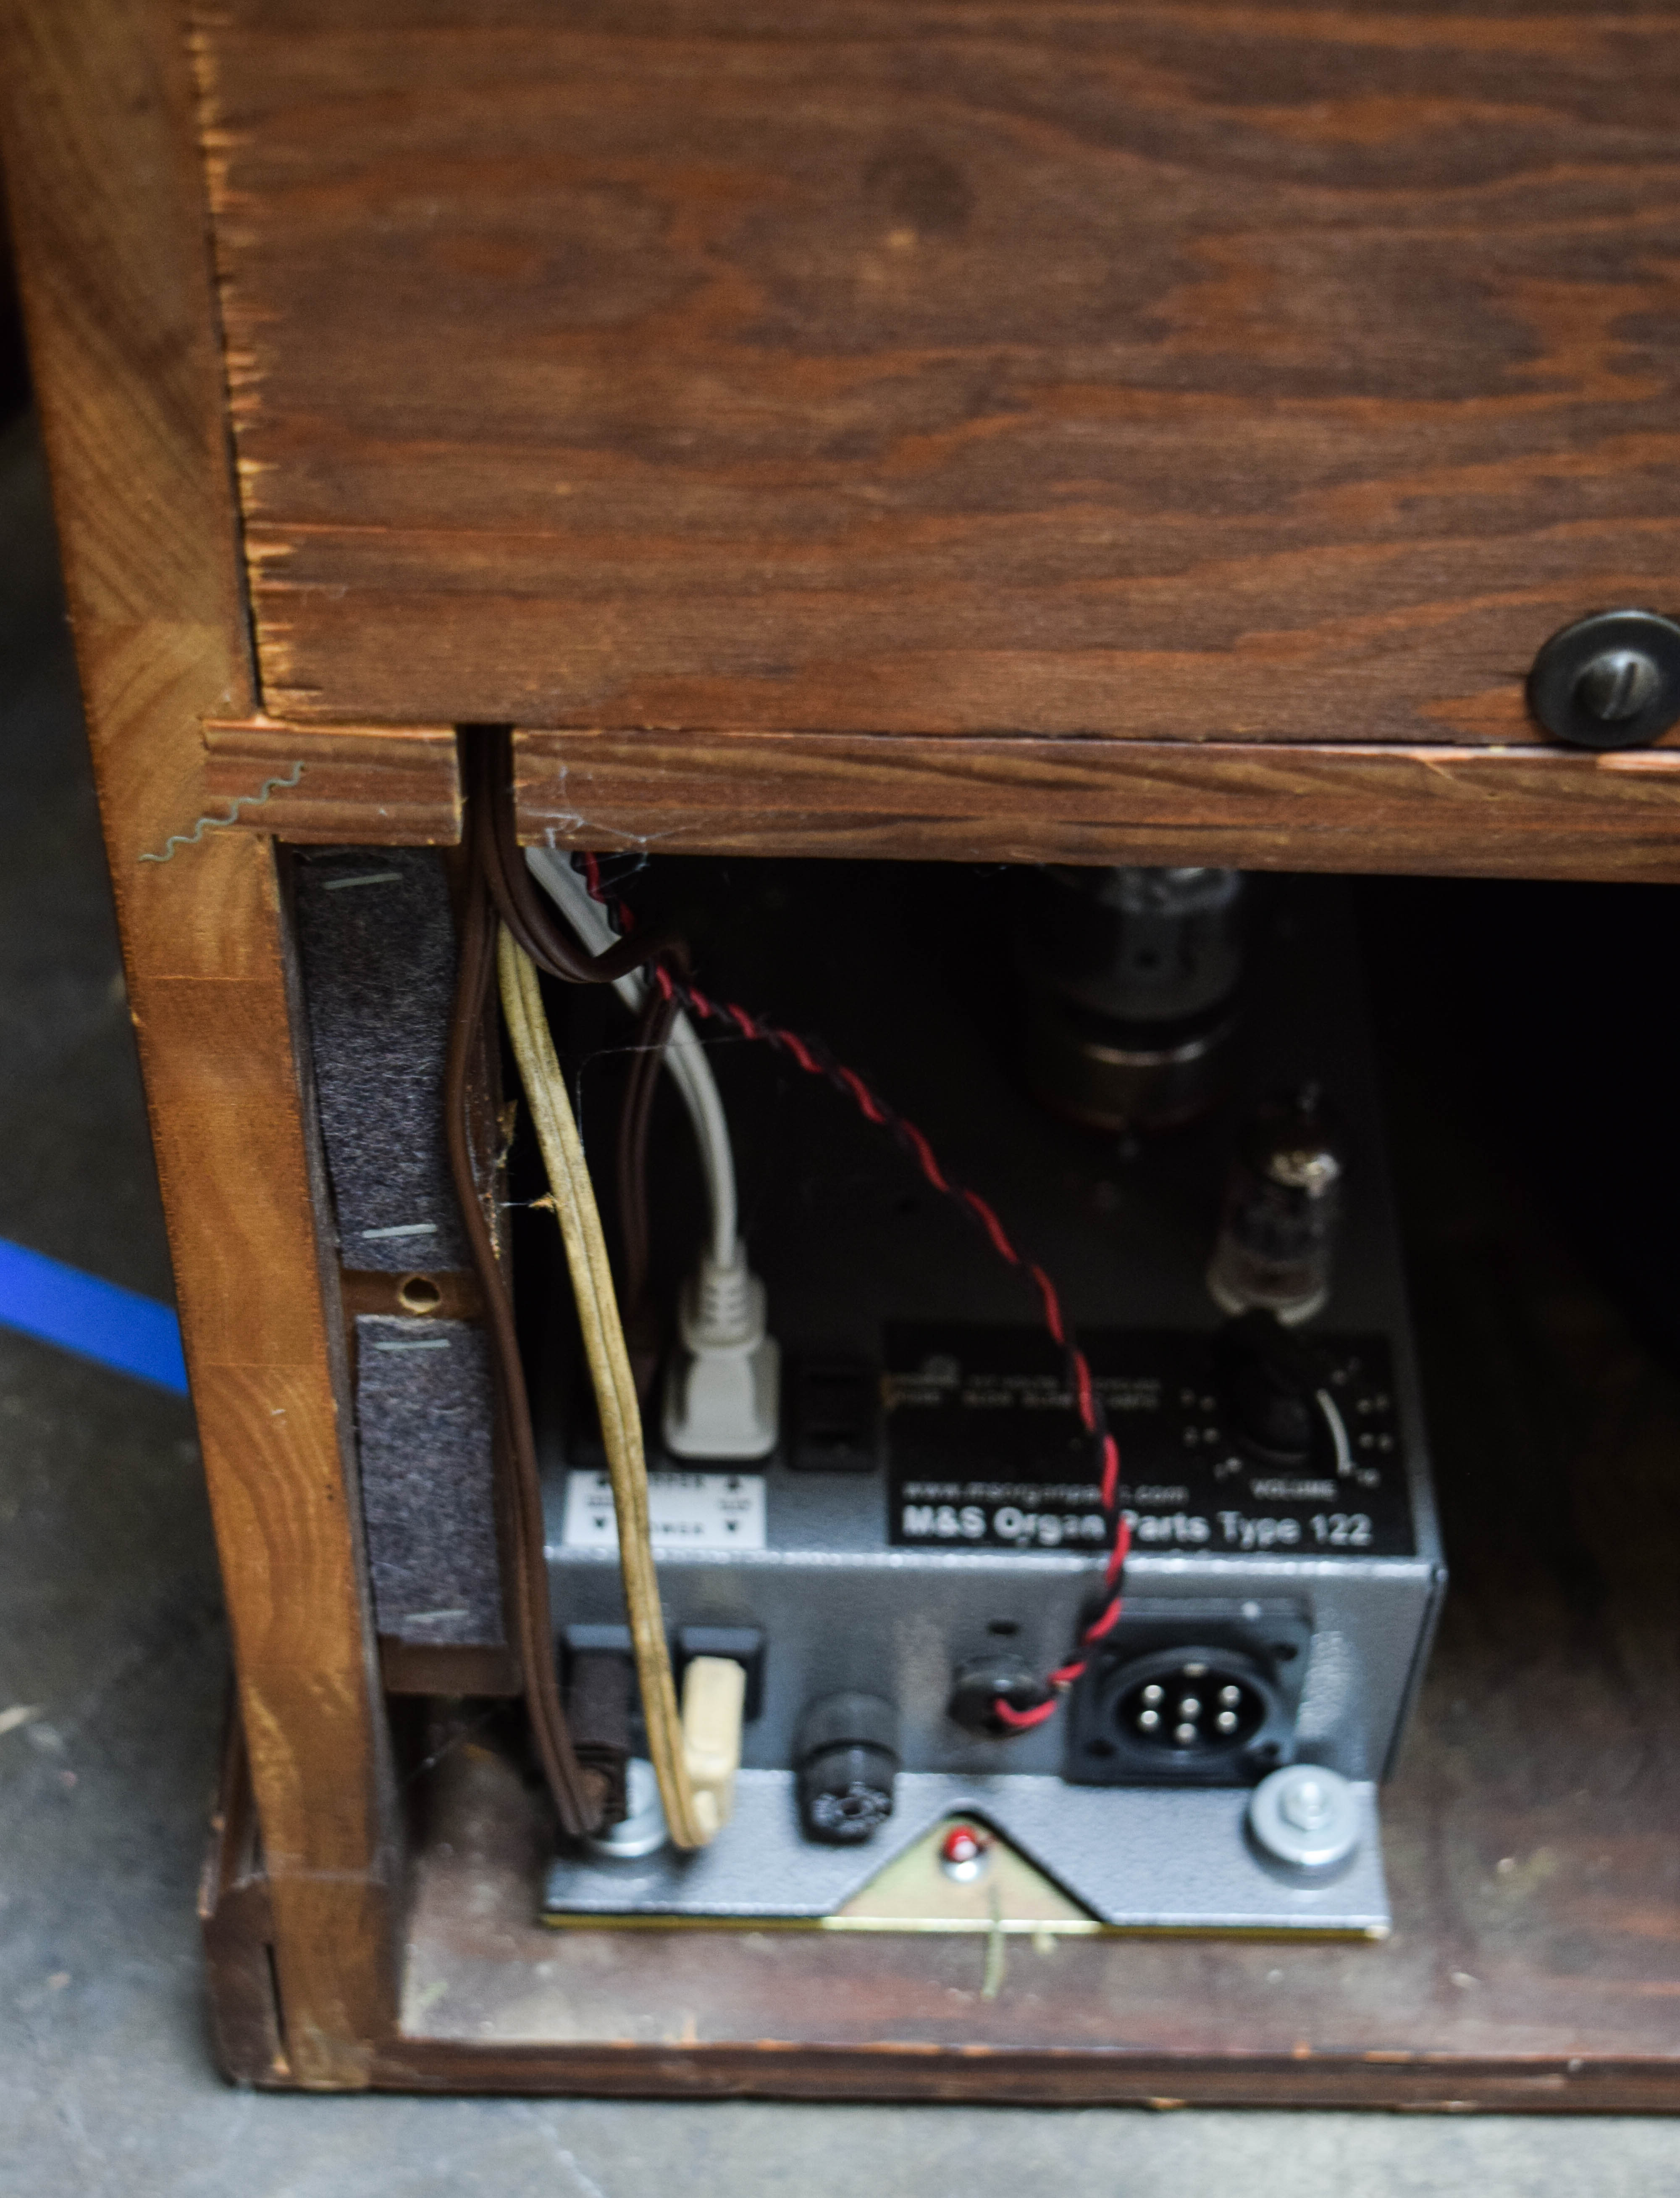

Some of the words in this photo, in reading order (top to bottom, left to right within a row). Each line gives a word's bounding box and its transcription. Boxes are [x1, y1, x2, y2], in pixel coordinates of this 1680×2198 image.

[902, 1504, 986, 1538] M&S
[993, 1506, 1106, 1546] Organ
[1218, 1511, 1301, 1550] Type
[1310, 1513, 1373, 1546] 122
